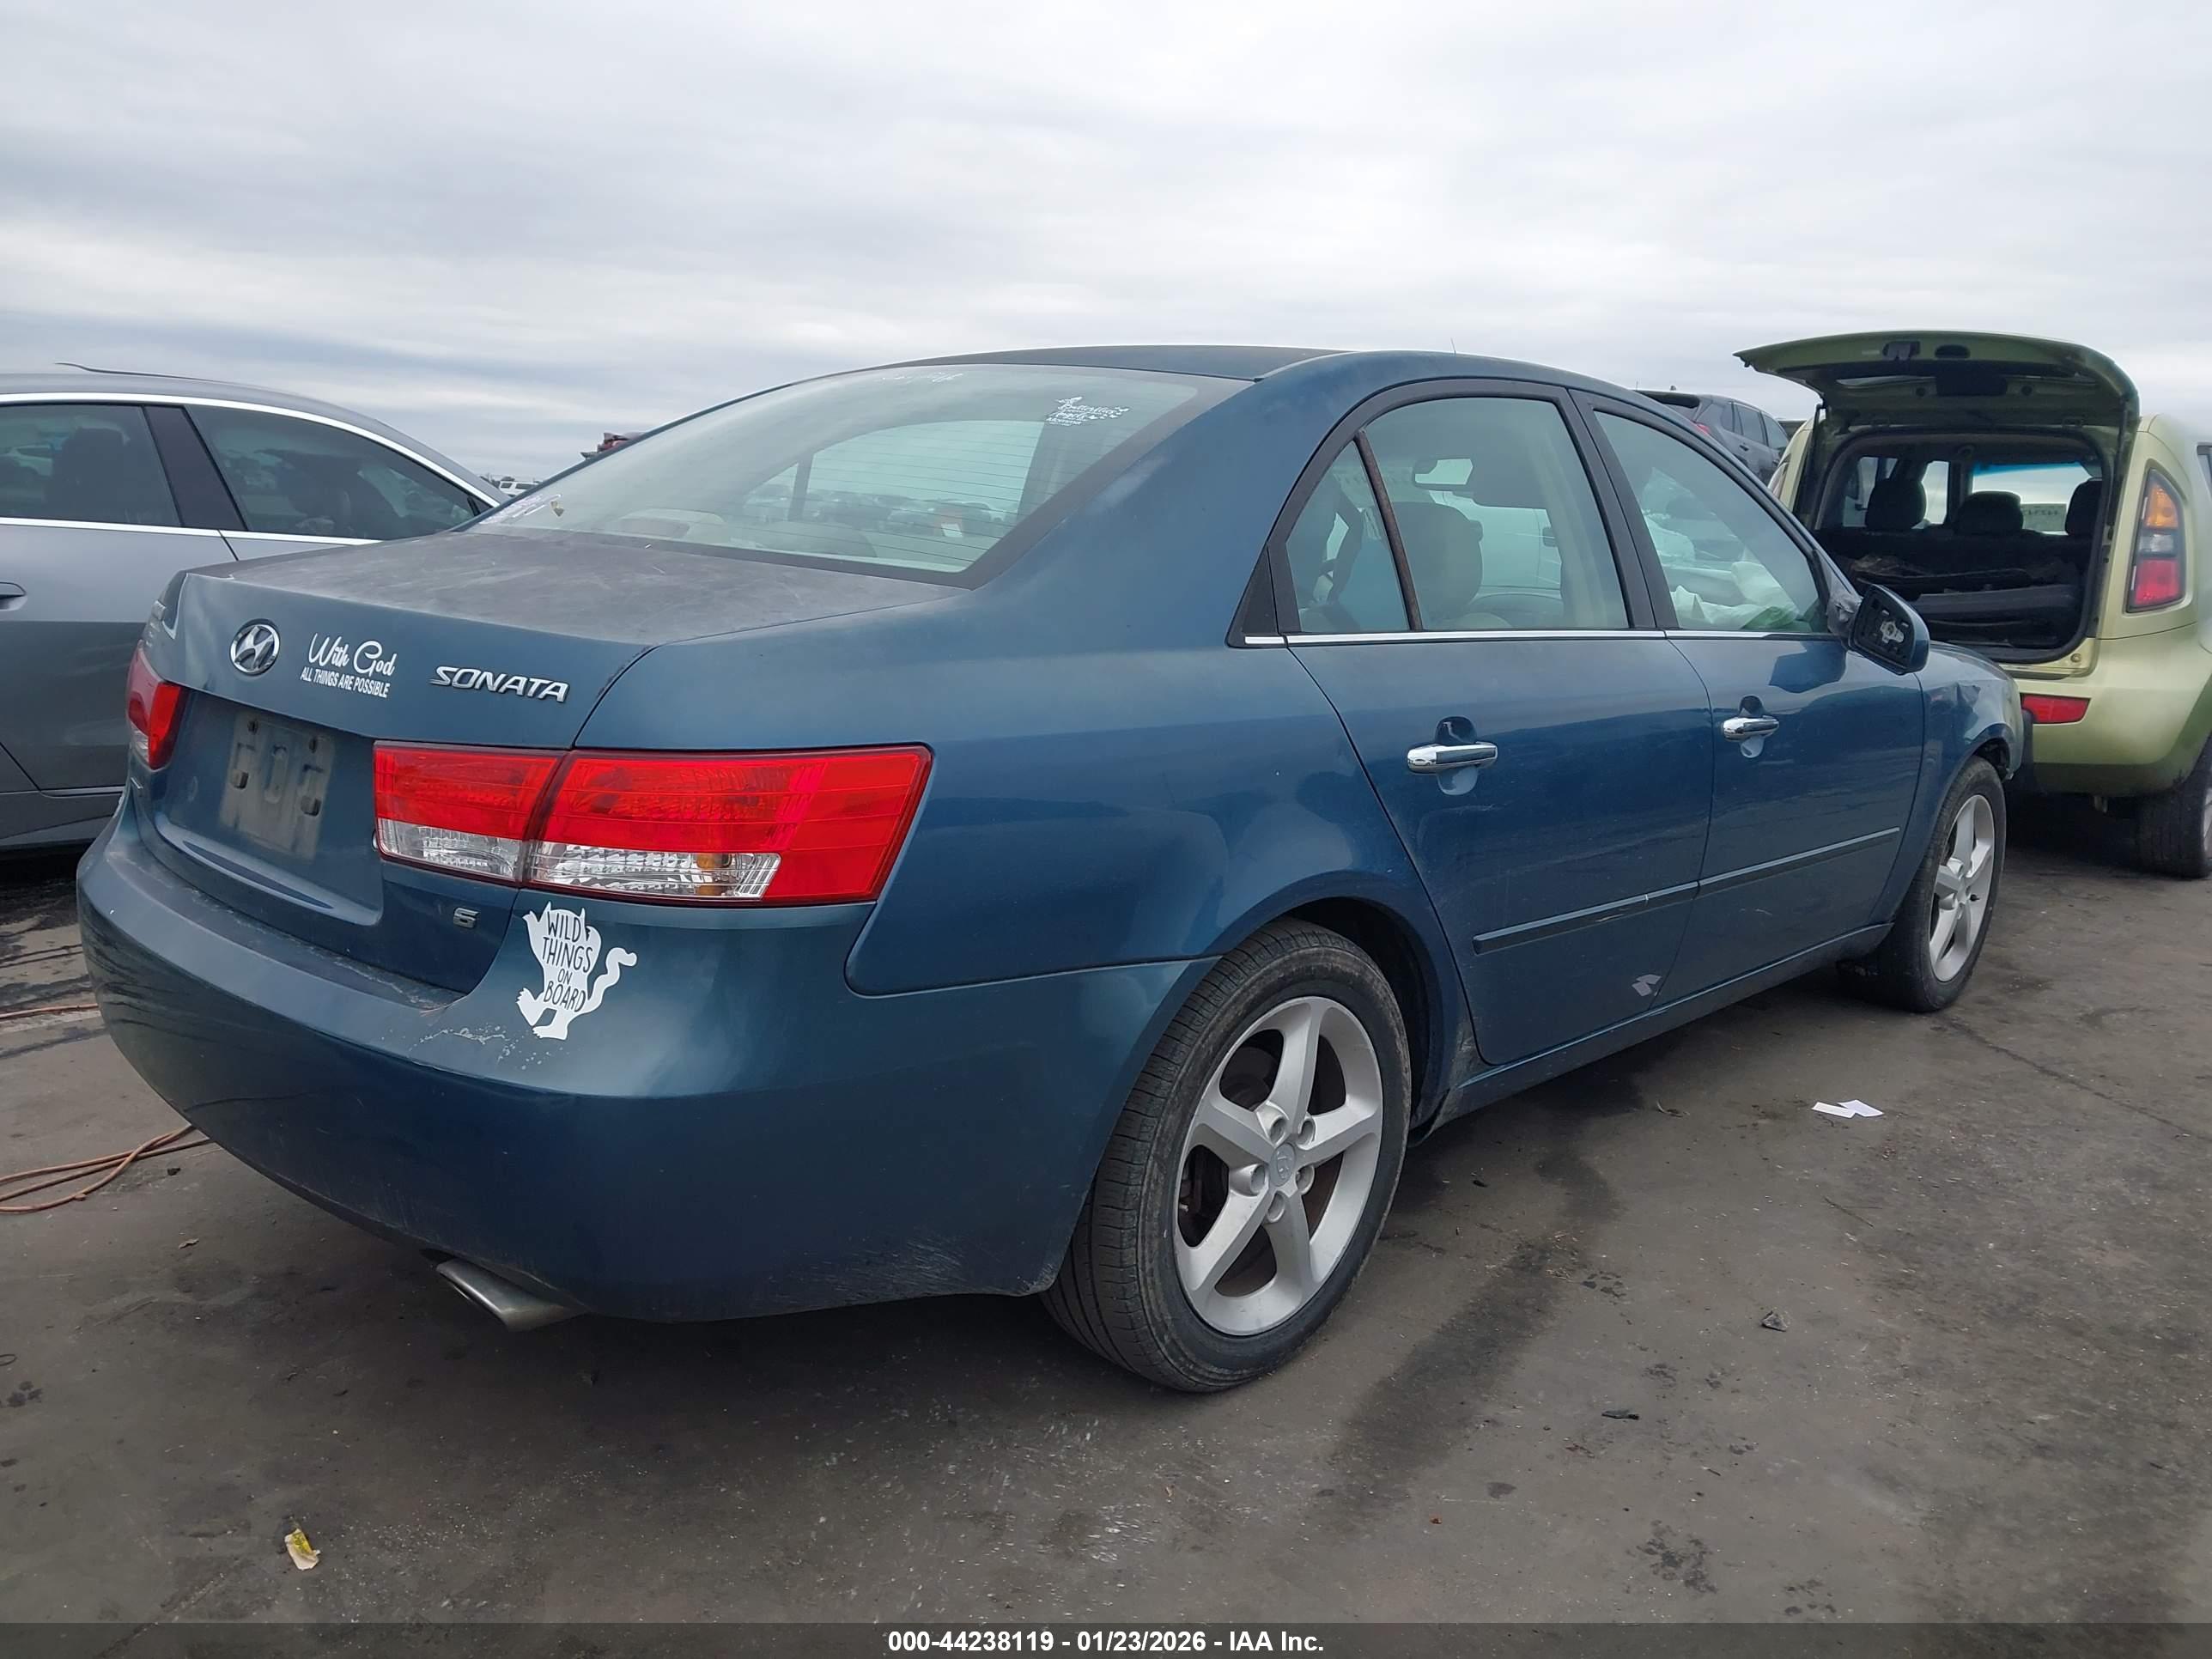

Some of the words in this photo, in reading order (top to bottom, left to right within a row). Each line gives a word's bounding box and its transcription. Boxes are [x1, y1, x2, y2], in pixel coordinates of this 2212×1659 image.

[308, 632, 350, 667] With
[353, 640, 398, 677] God
[300, 665, 313, 683] ALL
[313, 668, 340, 688] THINGS
[337, 673, 355, 691] ARE
[352, 677, 391, 699] POSSIBLE
[429, 665, 569, 702] SONATA
[547, 910, 581, 943] WILD
[542, 936, 593, 974] THINGS
[557, 968, 573, 985] ON
[543, 980, 586, 1013] BOARD
